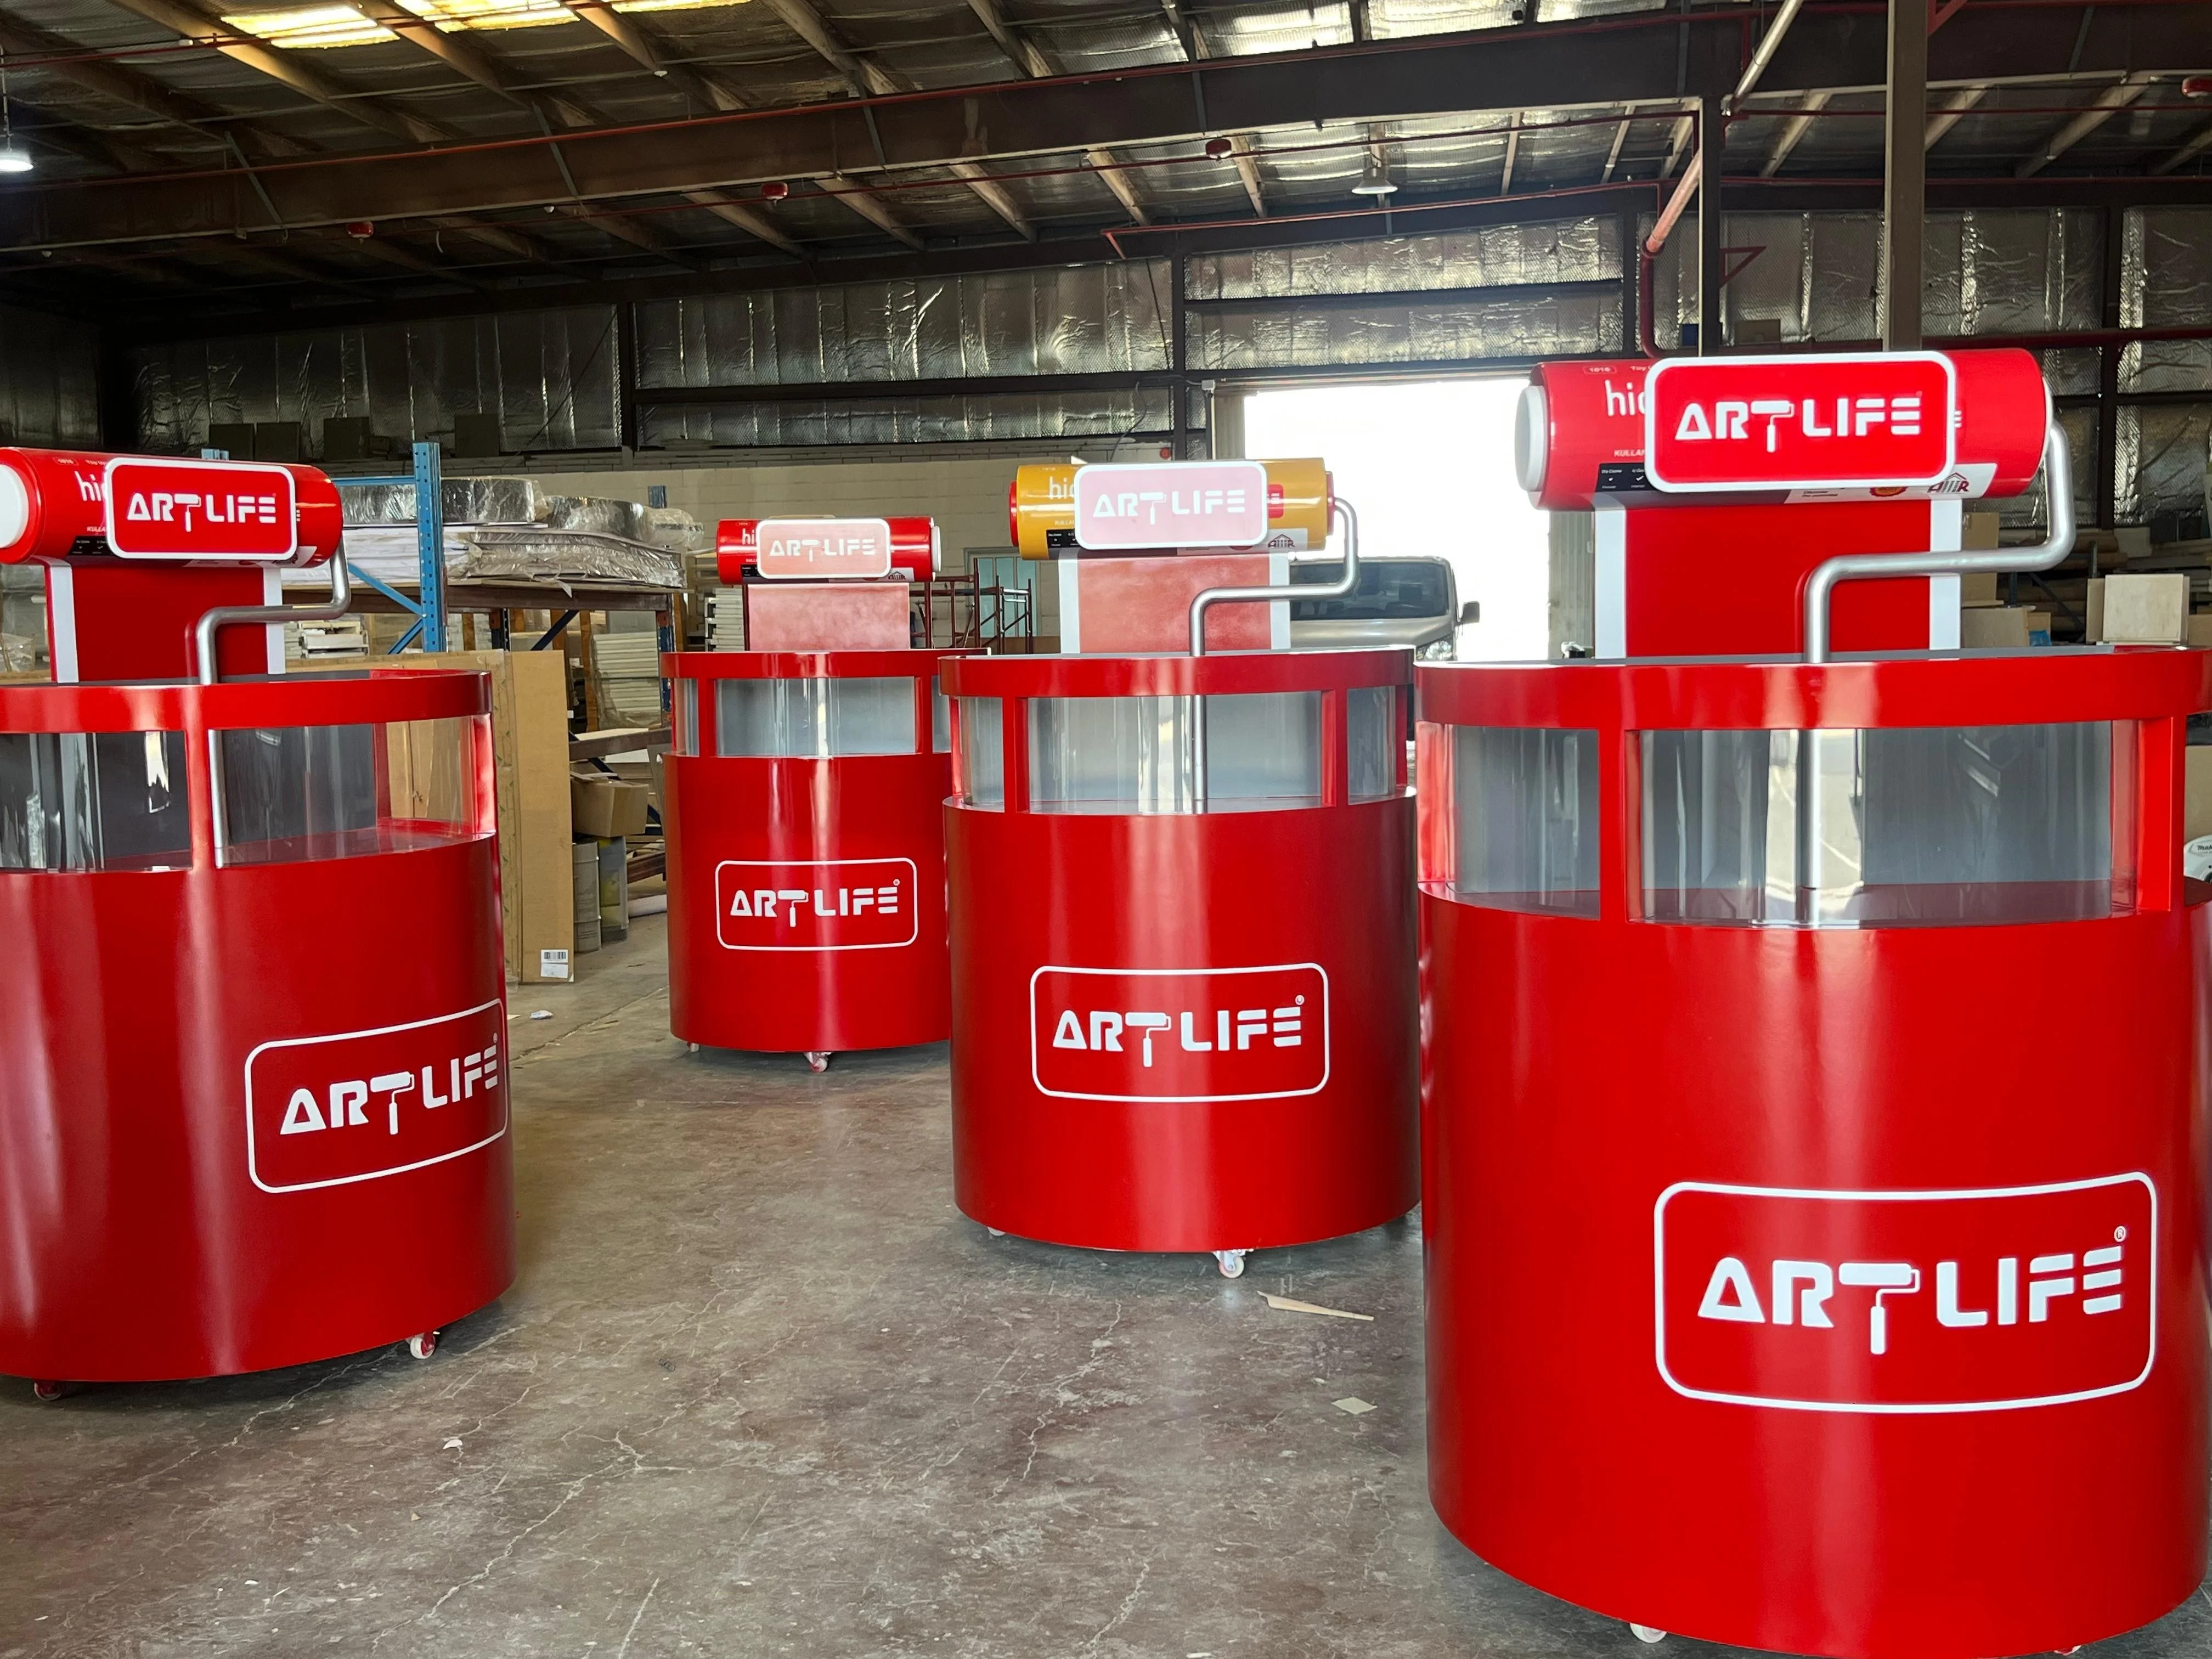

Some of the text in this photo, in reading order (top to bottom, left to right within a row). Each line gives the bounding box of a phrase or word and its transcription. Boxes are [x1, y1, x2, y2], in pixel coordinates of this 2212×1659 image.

[1675, 397, 1920, 453] ARTLIFE
[127, 492, 276, 532] ARTLIFE
[1093, 489, 1245, 525] ARTLIFE
[769, 539, 876, 562] ARTLIFE
